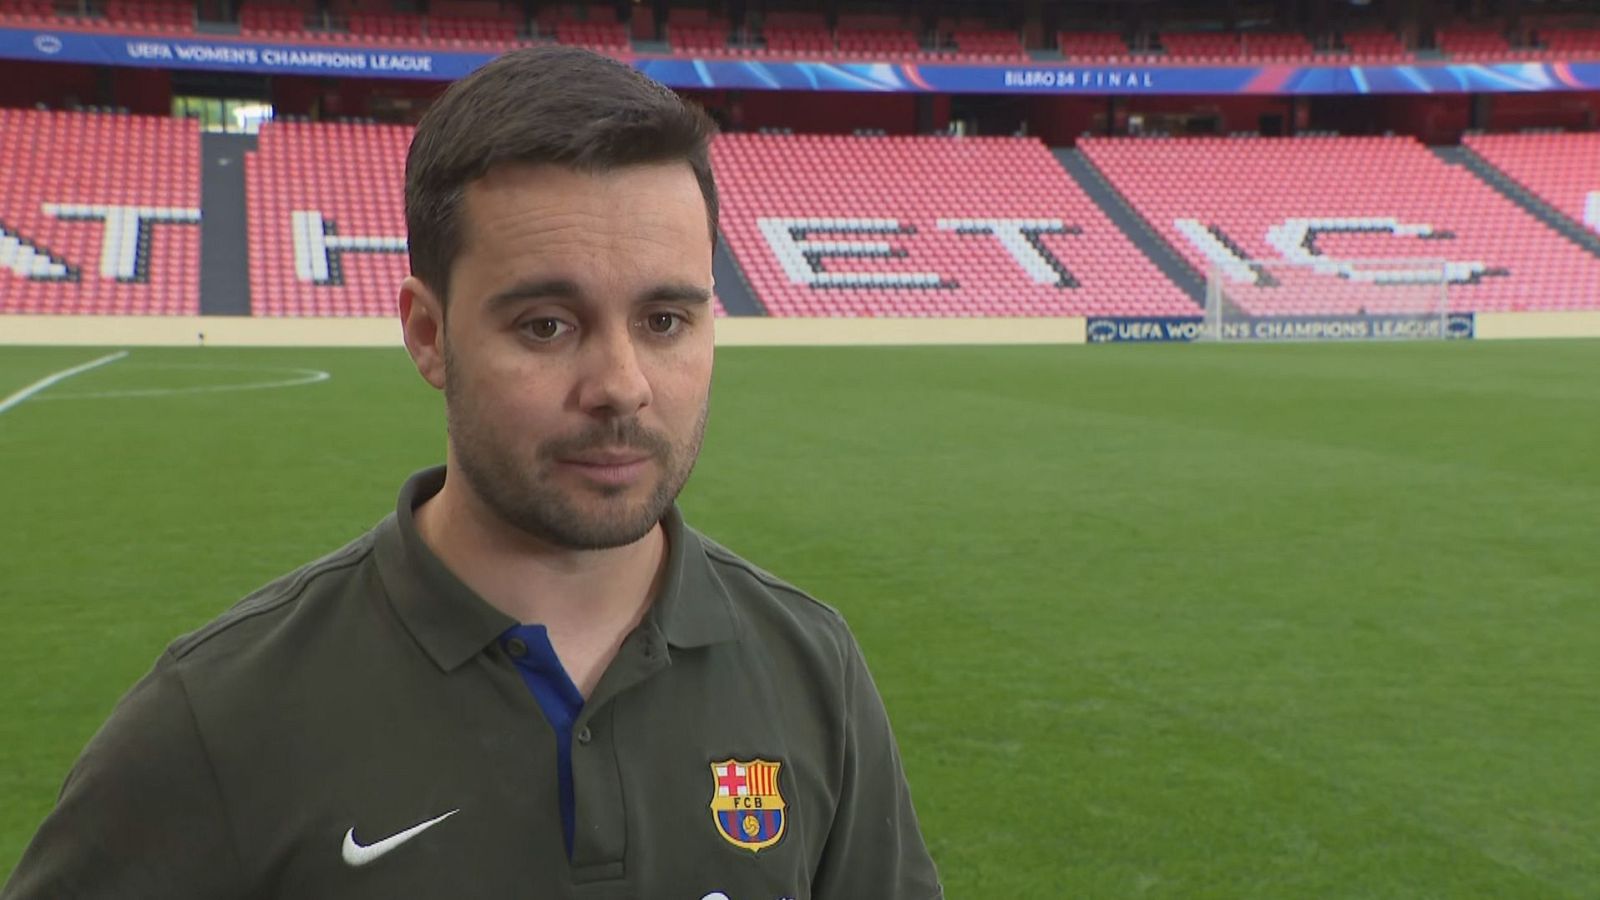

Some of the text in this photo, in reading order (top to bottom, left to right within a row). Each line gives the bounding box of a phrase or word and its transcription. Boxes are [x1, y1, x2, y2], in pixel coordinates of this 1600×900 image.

[127, 43, 173, 59] UEFA
[261, 50, 367, 69] CHAMPIONS
[369, 55, 433, 72] LEAGUE
[1082, 71, 1153, 87] FINAL
[1118, 322, 1163, 340] UEFA
[1255, 321, 1369, 338] CHAMPIONS
[1373, 319, 1440, 337] LEAGUE
[734, 797, 762, 809] FCB
